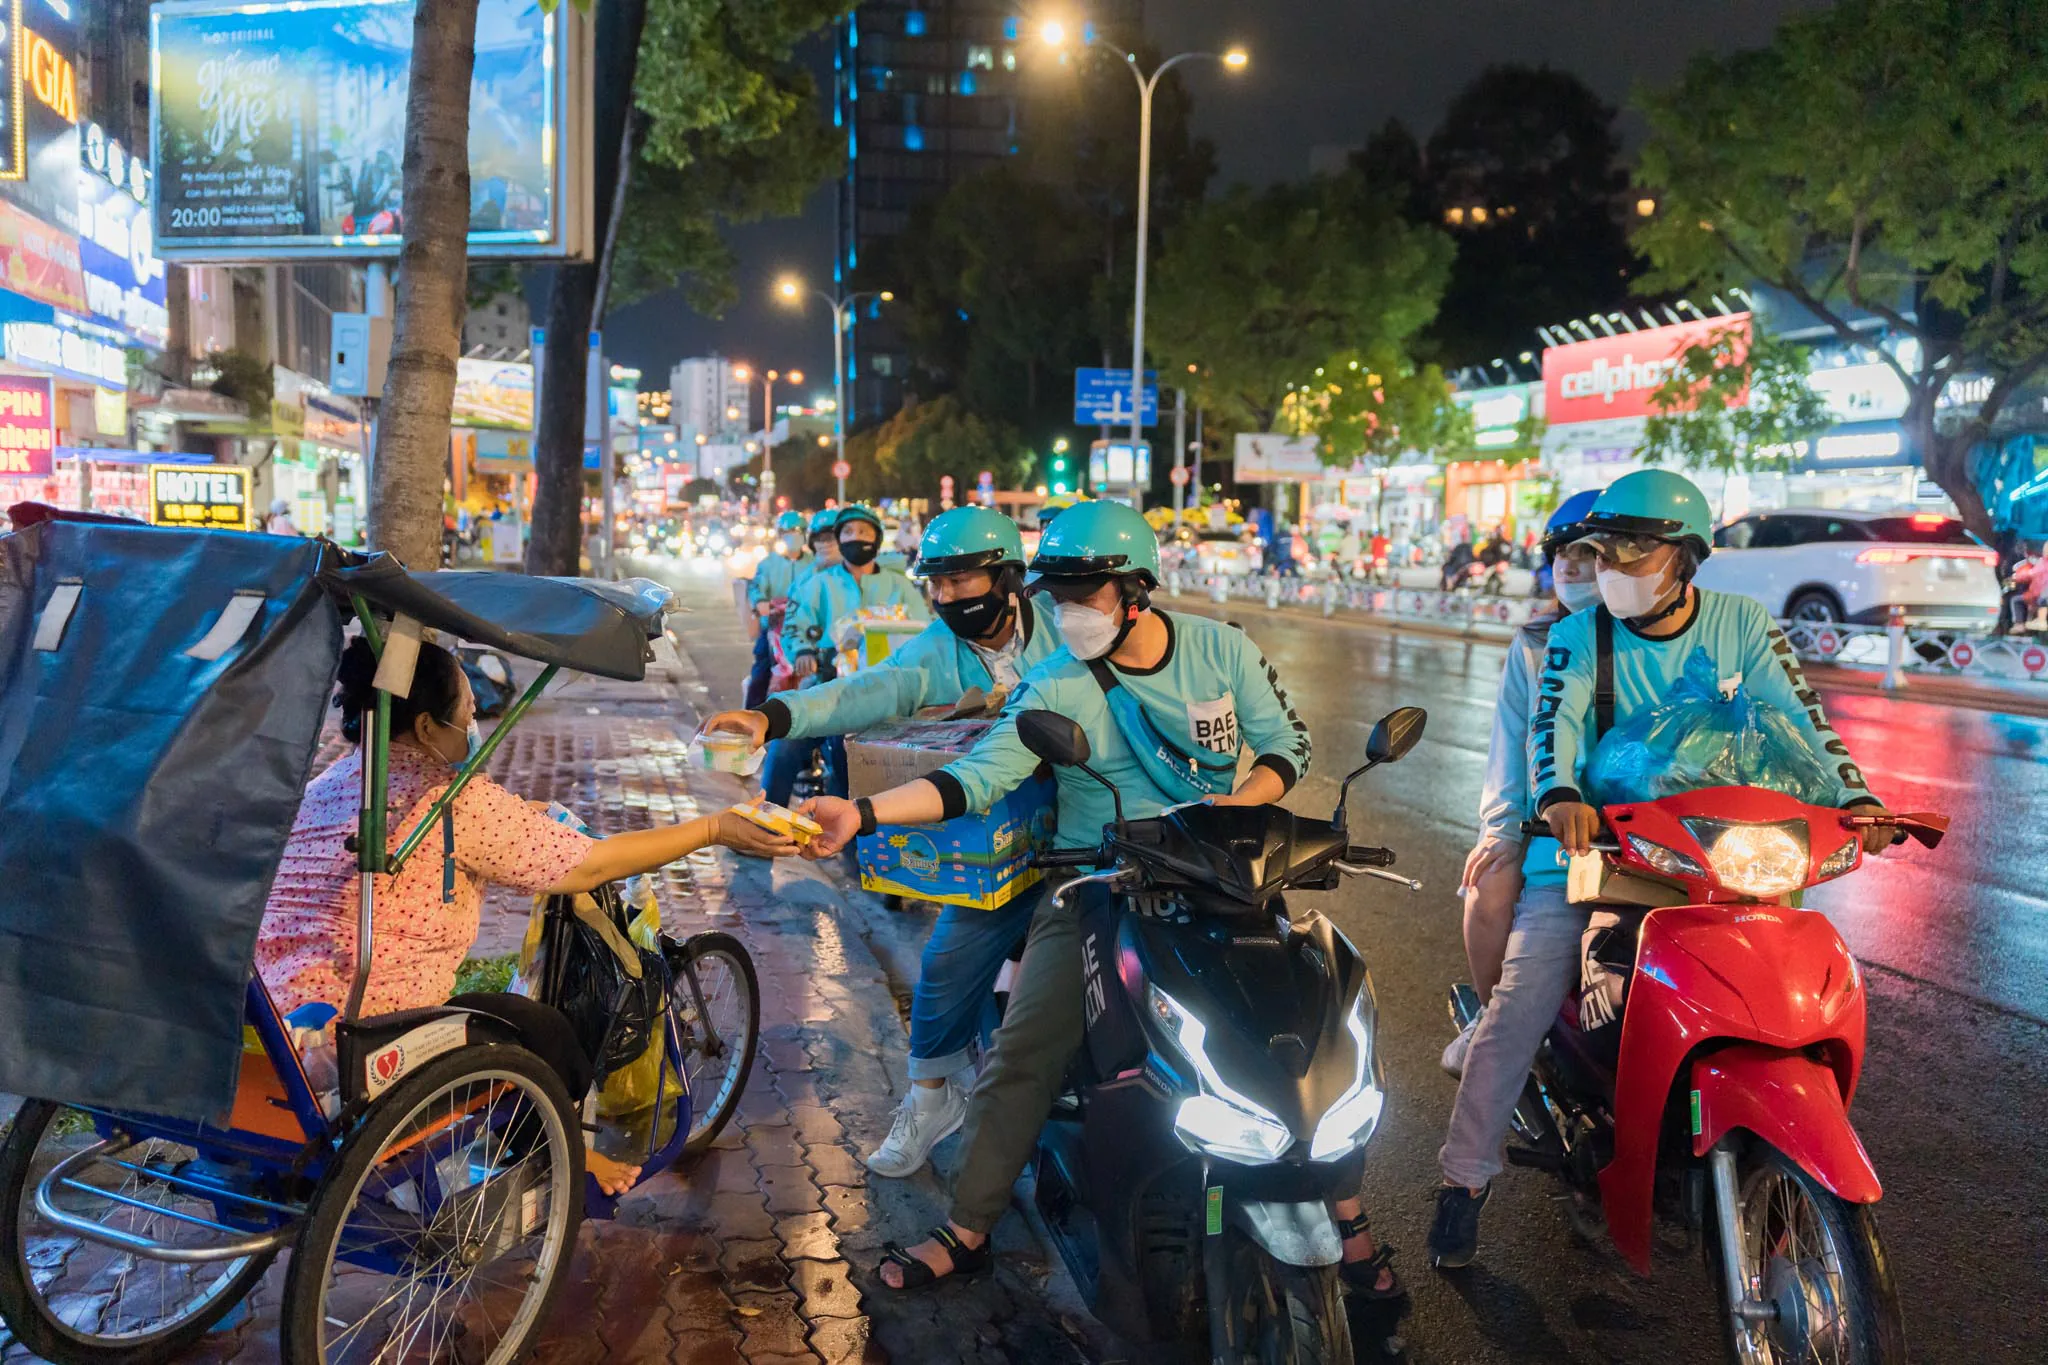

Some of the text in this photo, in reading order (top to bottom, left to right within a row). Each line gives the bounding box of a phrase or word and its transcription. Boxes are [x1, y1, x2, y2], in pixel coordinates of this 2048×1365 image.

[171, 207, 221, 228] 20:00
[1560, 353, 1692, 404] cellpho
[157, 471, 244, 503] HOTEL
[1196, 711, 1235, 738] BAE
[1734, 914, 1783, 924] HONDA
[1145, 1066, 1173, 1097] HONDA
